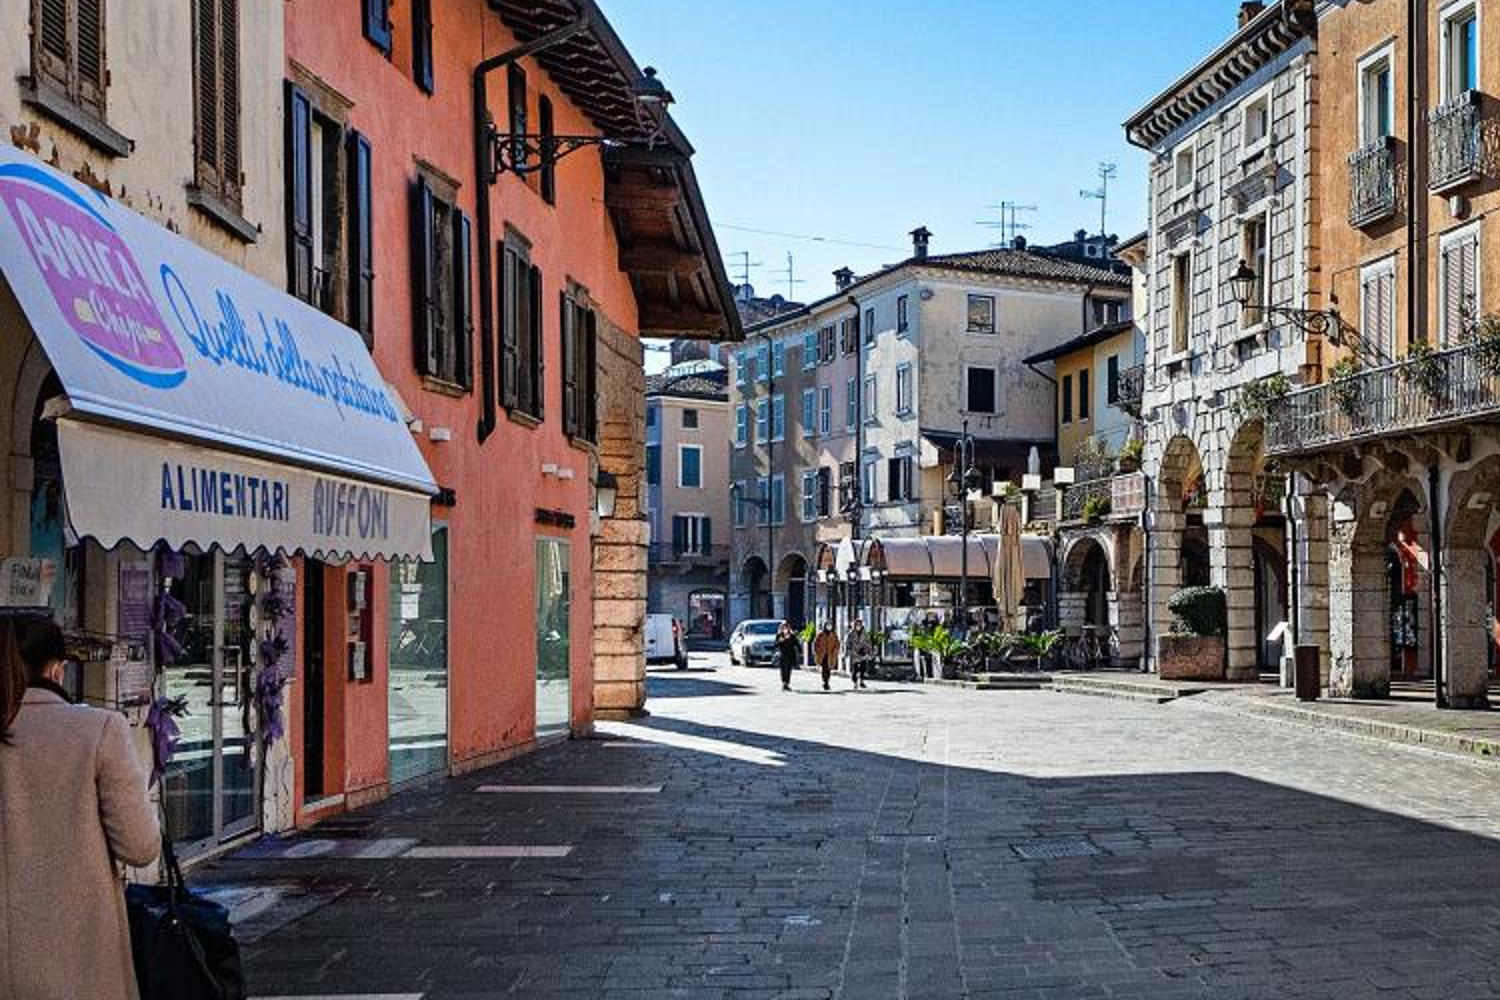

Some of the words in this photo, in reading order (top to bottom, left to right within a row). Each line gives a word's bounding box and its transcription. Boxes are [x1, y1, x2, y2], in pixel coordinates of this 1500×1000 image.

[15, 197, 151, 305] AMICA
[160, 263, 268, 376] Quelli
[161, 462, 289, 522] ALIMENTARI
[313, 477, 389, 540] RUFFONI
